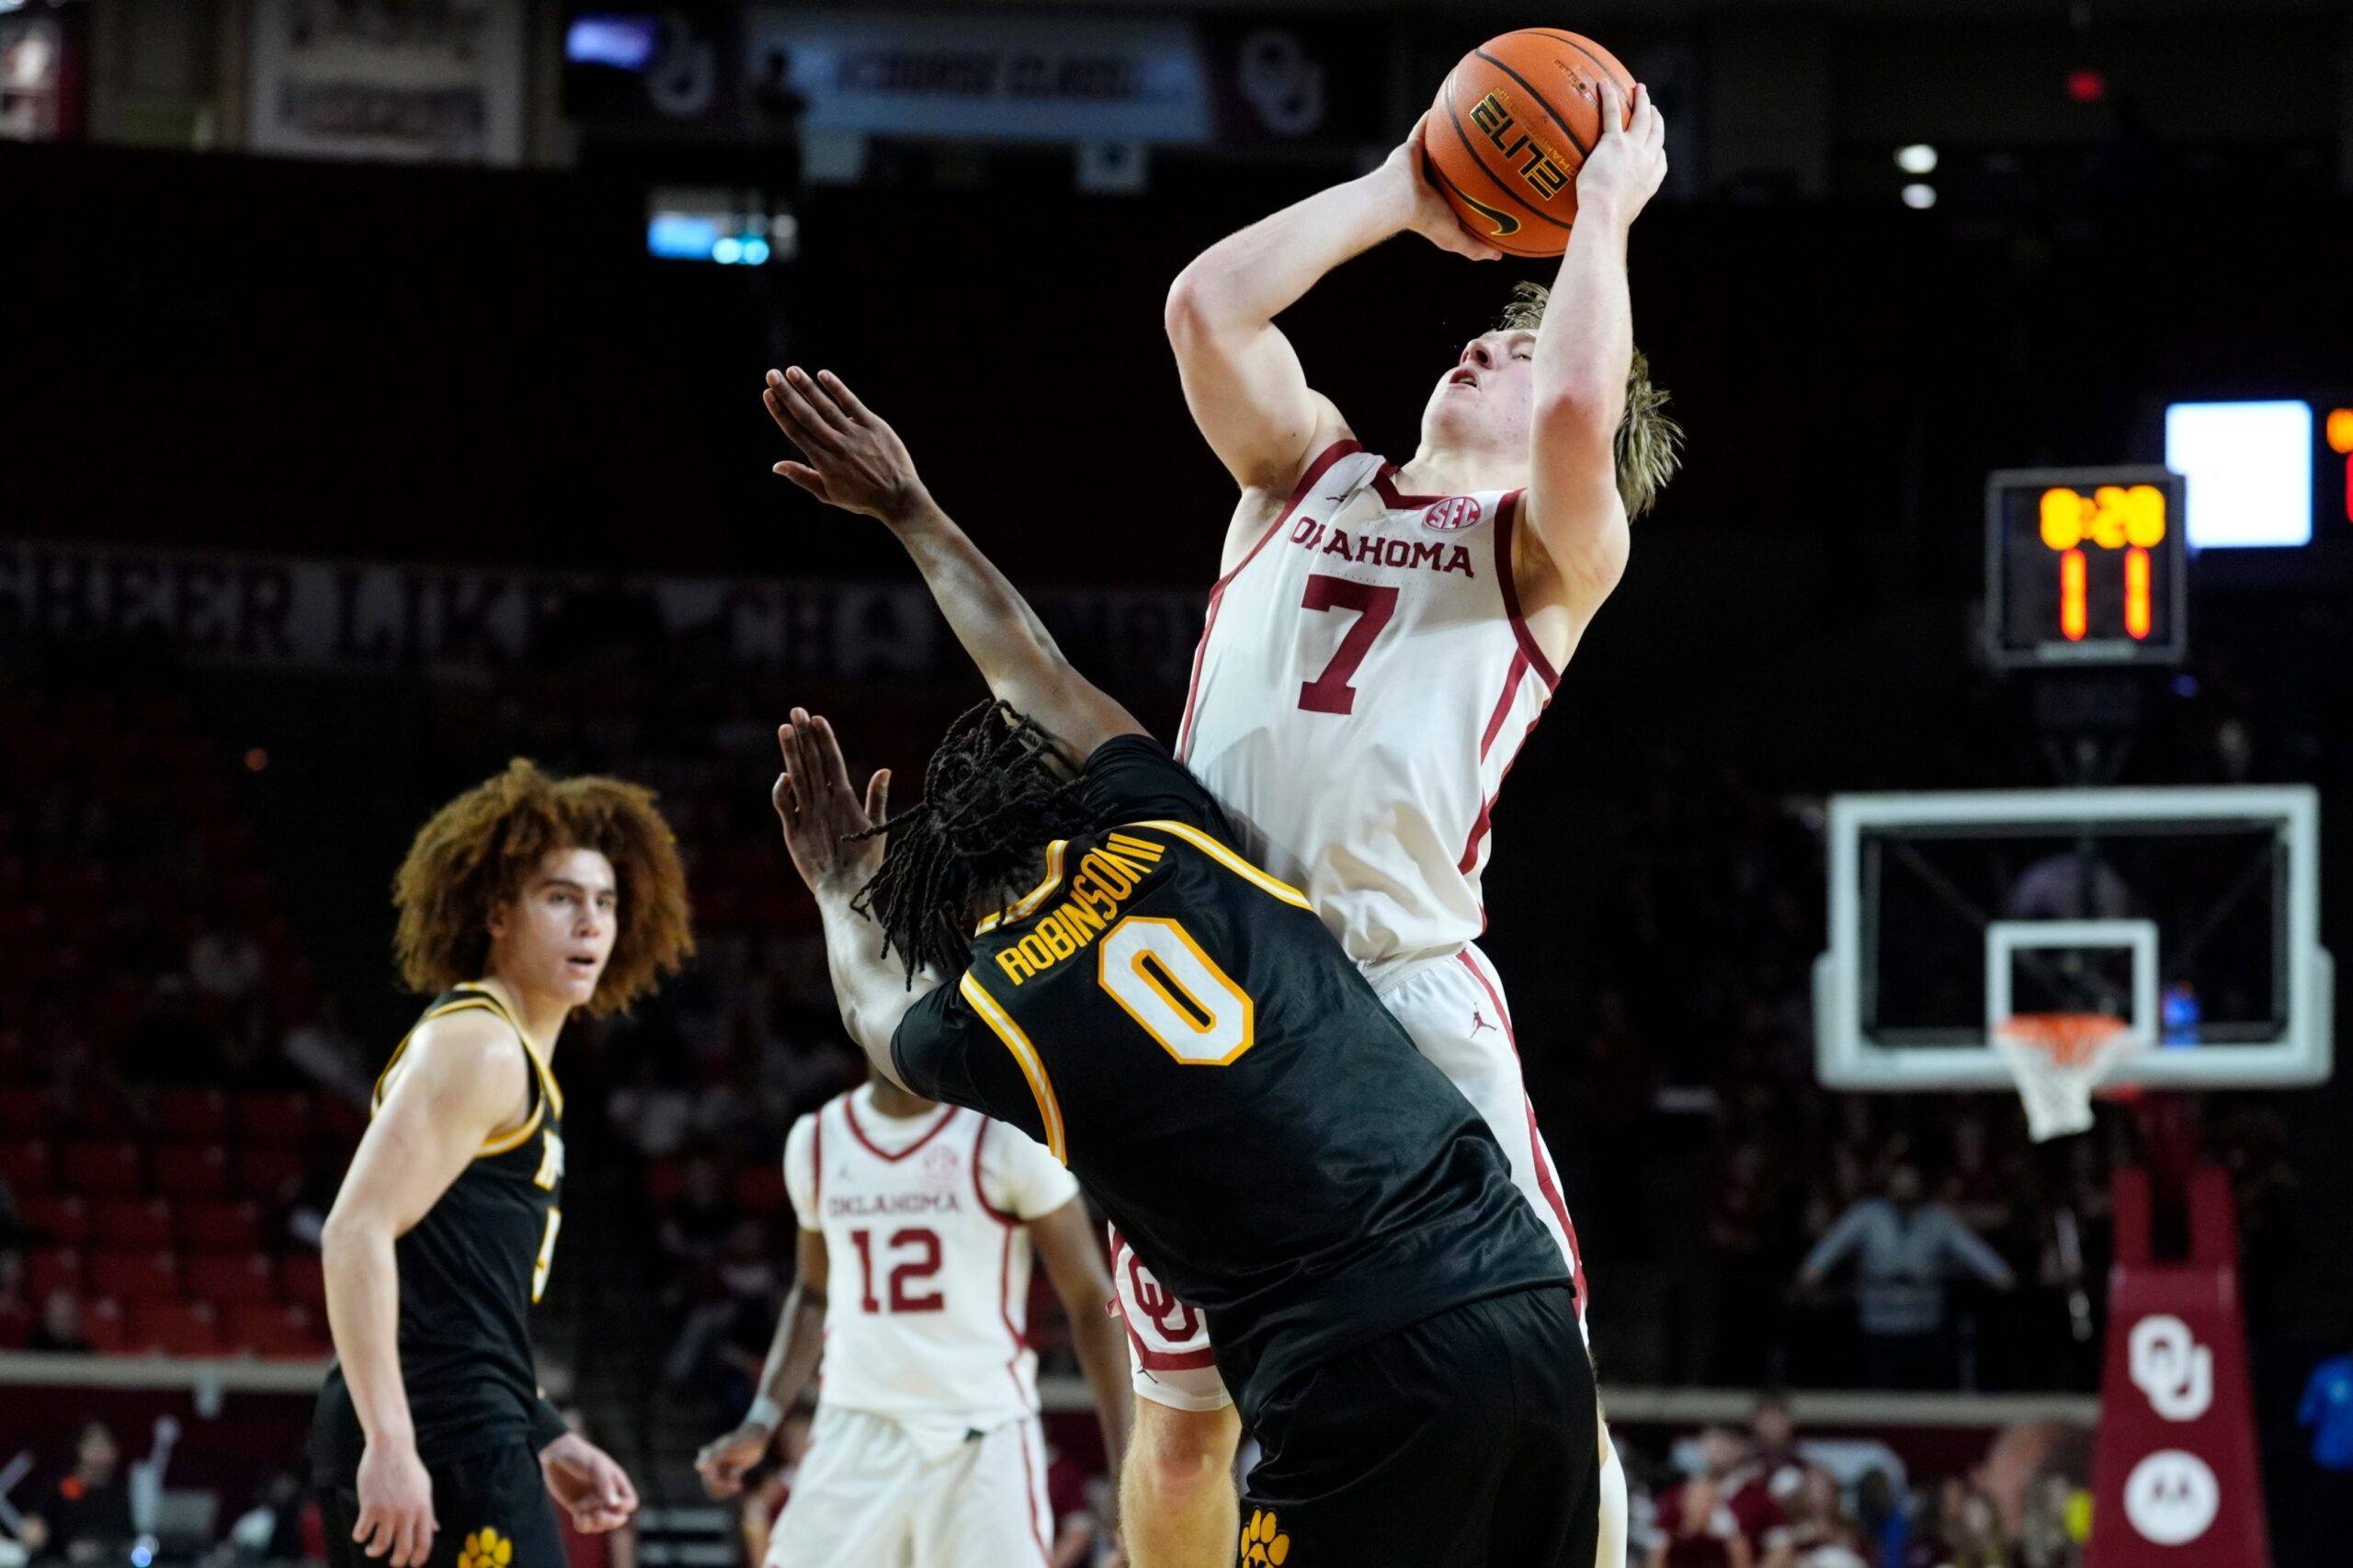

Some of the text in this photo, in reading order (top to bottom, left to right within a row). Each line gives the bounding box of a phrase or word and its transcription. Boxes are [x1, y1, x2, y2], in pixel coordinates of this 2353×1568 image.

[1470, 92, 1571, 200] ELITE
[1290, 516, 1474, 578] OKAHOMA
[1427, 496, 1481, 530] SEC
[2060, 548, 2152, 641] 11
[1298, 574, 1400, 715] 7
[995, 847, 1152, 986] ROBINSON
[1097, 915, 1255, 1066] 0
[828, 1193, 962, 1218] OKLAHOMA
[851, 1228, 944, 1312] 12
[1128, 1253, 1199, 1343] OU
[2127, 1313, 2213, 1422] OU
